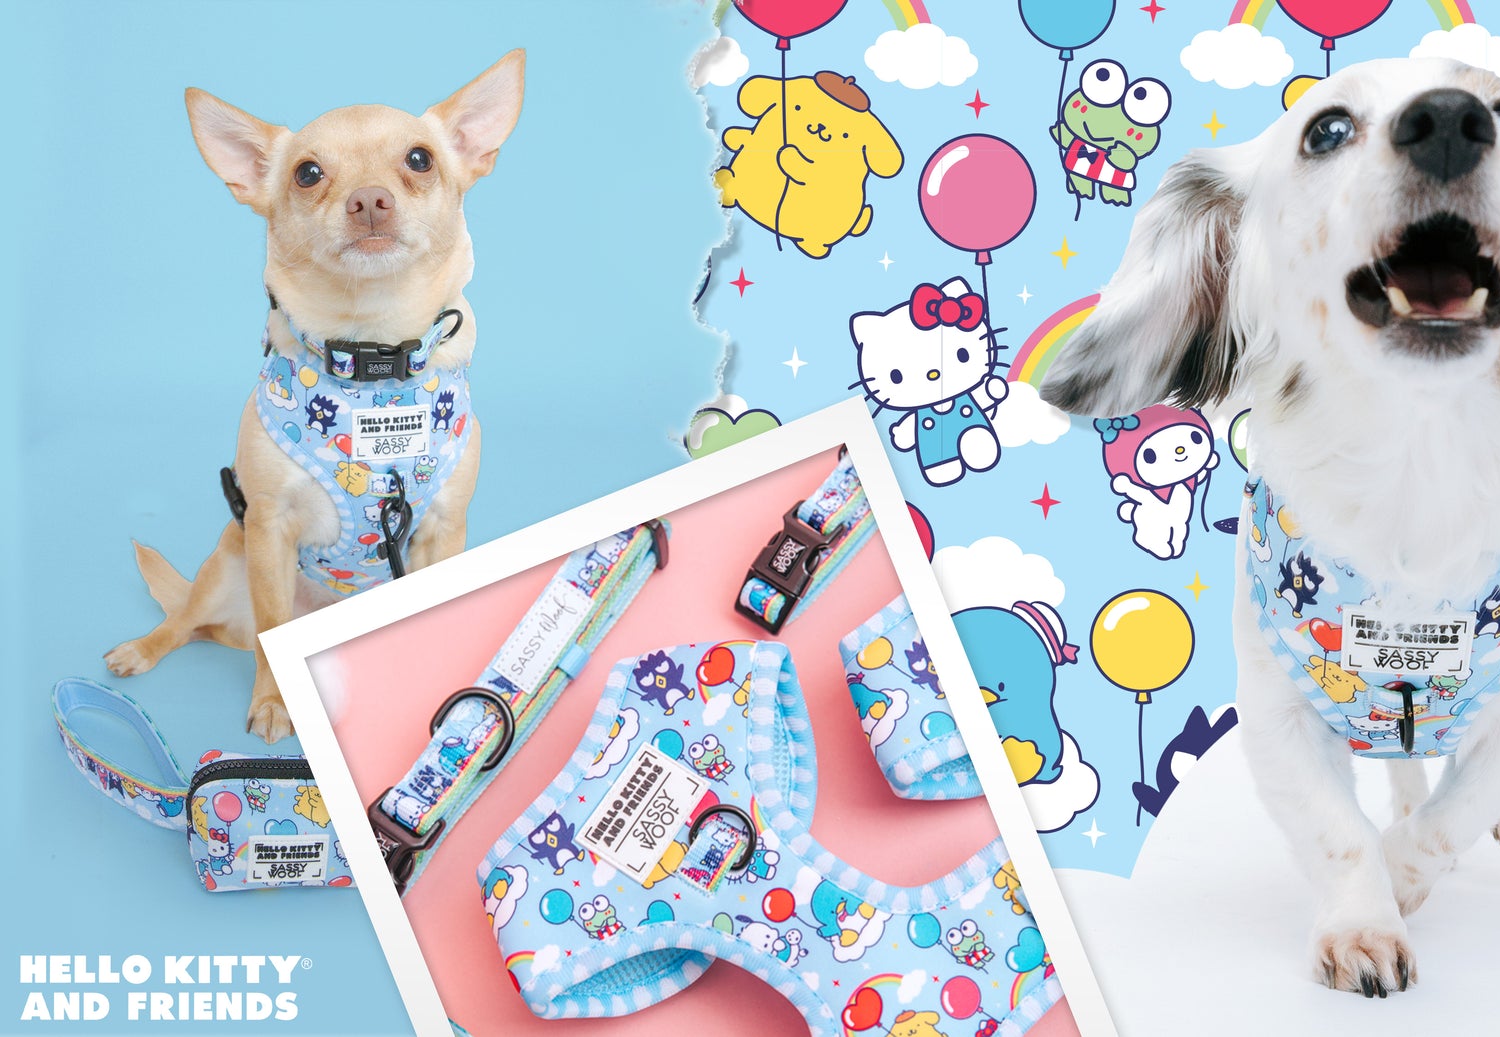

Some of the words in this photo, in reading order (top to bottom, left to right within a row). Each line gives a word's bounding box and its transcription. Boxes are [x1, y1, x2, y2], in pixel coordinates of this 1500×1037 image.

[361, 417, 390, 425] HELLO
[393, 414, 423, 423] KITTY
[361, 425, 381, 433] AND
[385, 423, 422, 432] FRIENDS
[375, 437, 412, 447] SASSY
[372, 445, 409, 454] WOOF
[773, 538, 794, 567] SASSY
[511, 631, 544, 675] SASSY
[539, 593, 577, 632] Woof
[1410, 624, 1461, 634] KITTY
[1378, 649, 1439, 661] SASSY
[1374, 657, 1434, 670] WOOF
[591, 800, 623, 840] HELLO
[620, 757, 653, 799] KITTY
[603, 818, 625, 847] AND
[623, 765, 663, 816] FRIENDS
[633, 789, 671, 841] SASSY
[640, 799, 679, 850] WOOF
[271, 863, 307, 871] SASSY
[268, 869, 304, 878] WOOF
